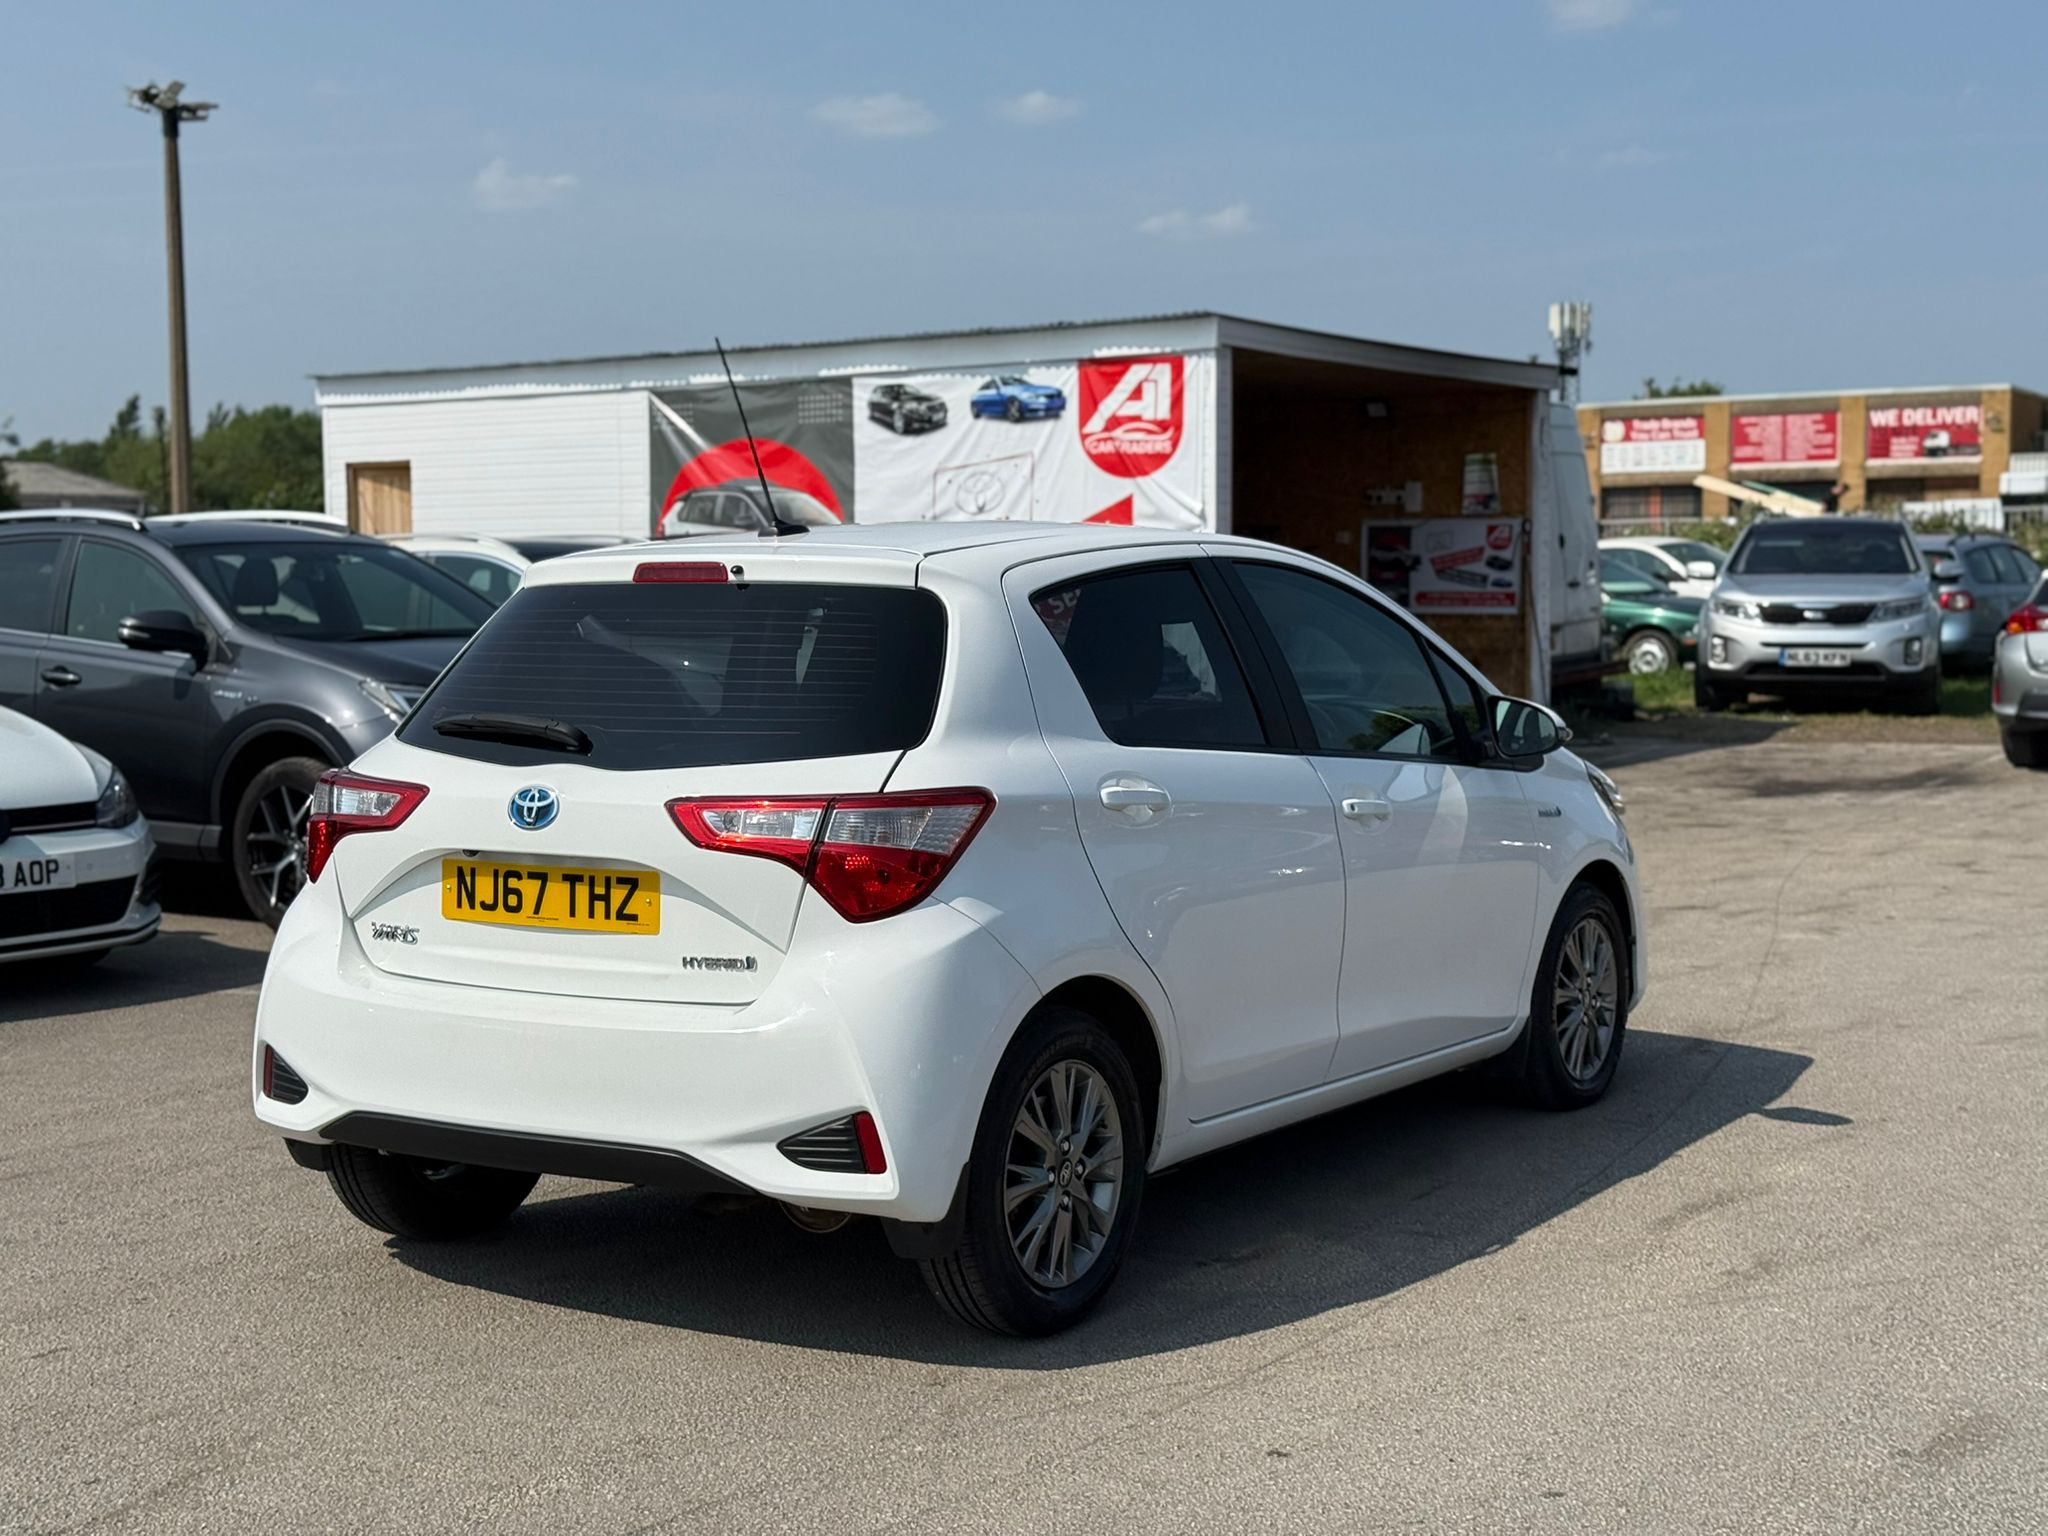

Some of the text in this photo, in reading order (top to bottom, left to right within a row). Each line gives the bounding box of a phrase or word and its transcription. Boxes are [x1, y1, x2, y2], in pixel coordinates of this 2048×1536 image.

[1869, 406, 1978, 427] WE DELIVER
[1084, 438, 1173, 455] CAR TRADERS
[14, 859, 59, 887] AOP
[456, 865, 639, 921] NJ67 THZ
[682, 956, 746, 972] HYBRID
